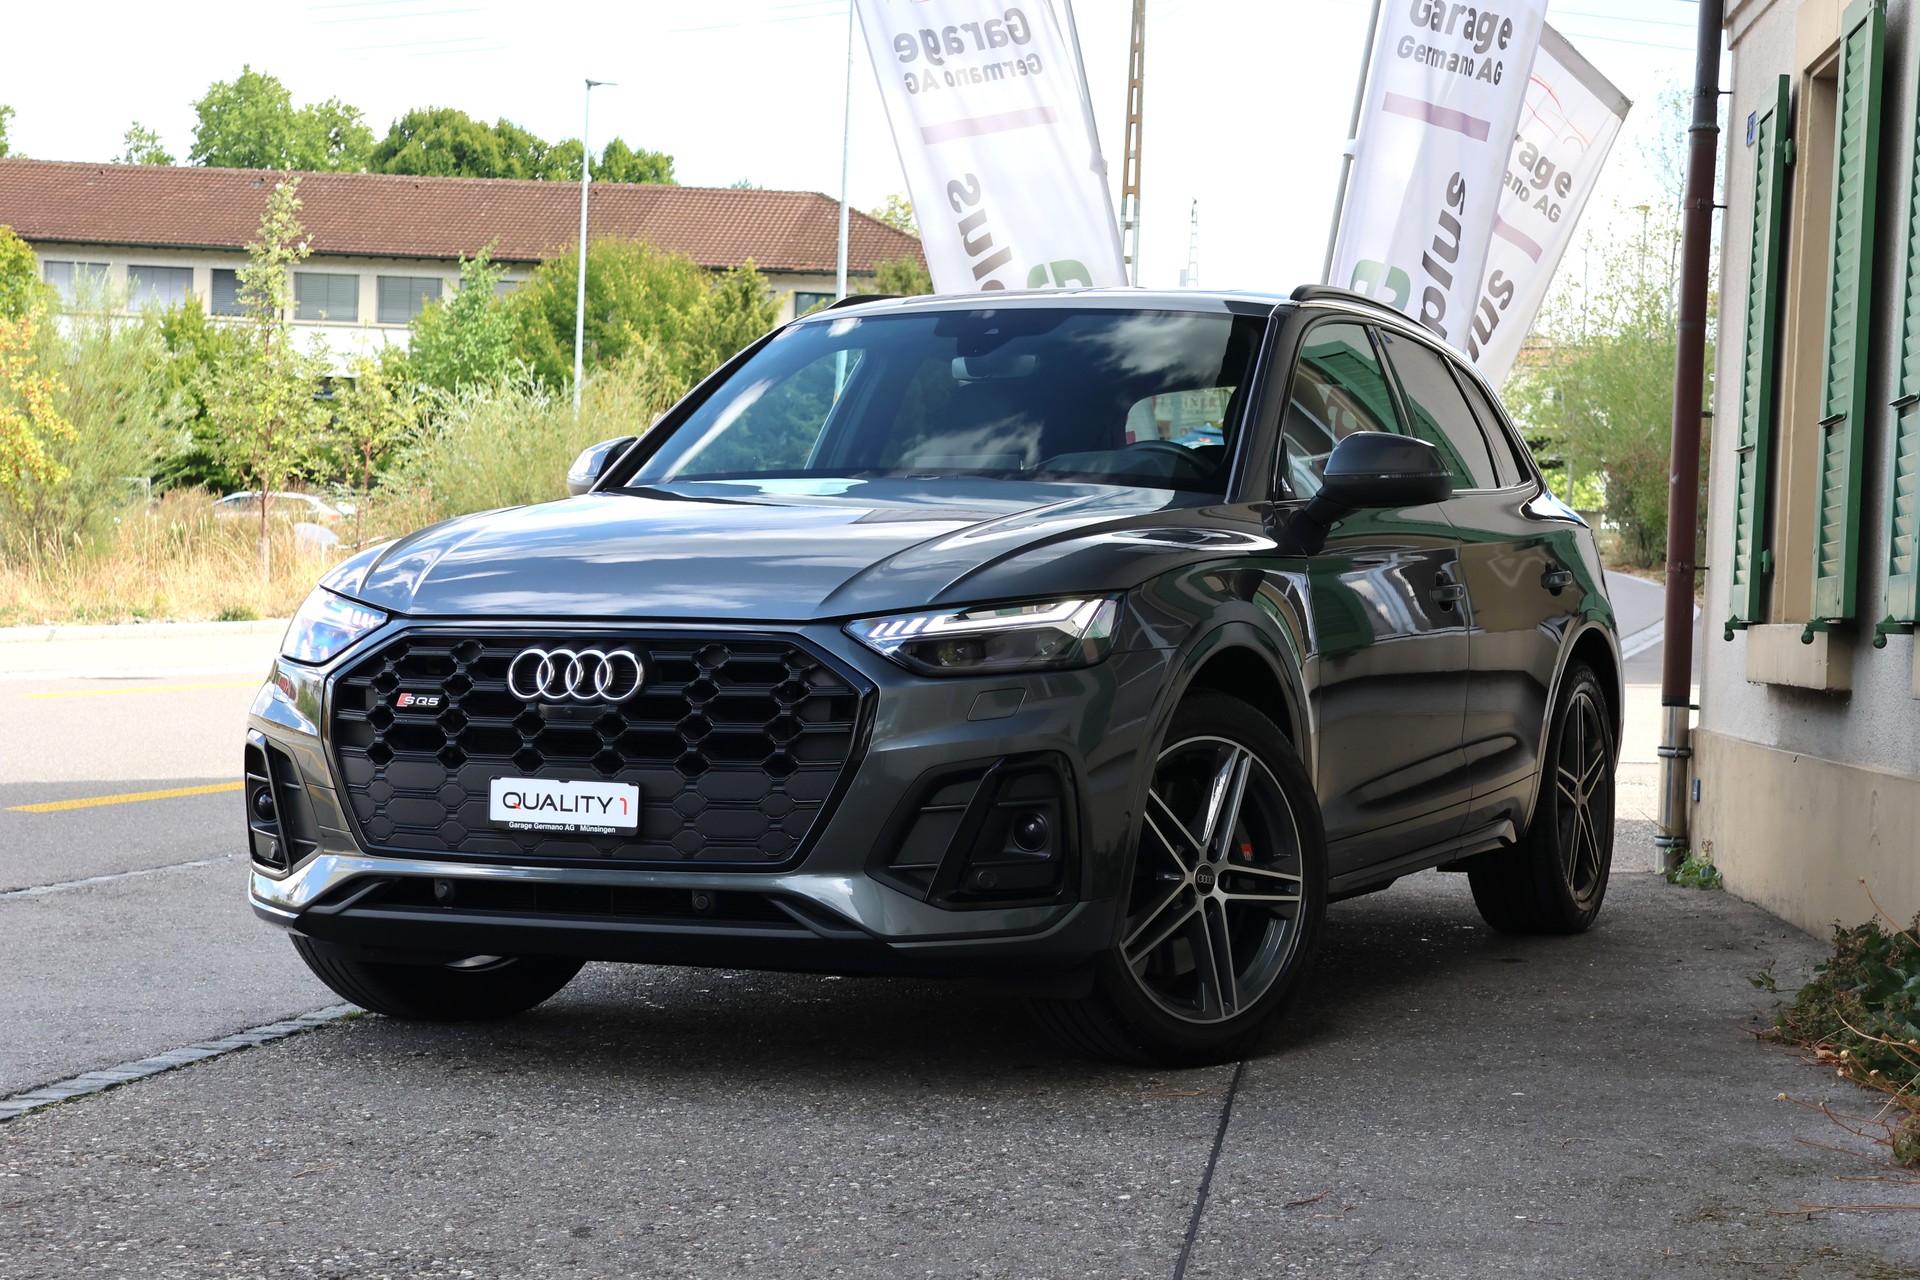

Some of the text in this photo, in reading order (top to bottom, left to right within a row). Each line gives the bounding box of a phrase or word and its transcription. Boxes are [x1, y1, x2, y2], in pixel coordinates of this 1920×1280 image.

[1409, 0, 1513, 54] Garage
[1397, 35, 1503, 86] Germano AG
[1515, 132, 1572, 199] age
[1532, 194, 1562, 223] AG
[1419, 171, 1466, 341] plus
[403, 695, 440, 707] SQ5
[503, 791, 613, 814] QUALITY
[508, 821, 616, 834] Garage Germano AG Münsingen
